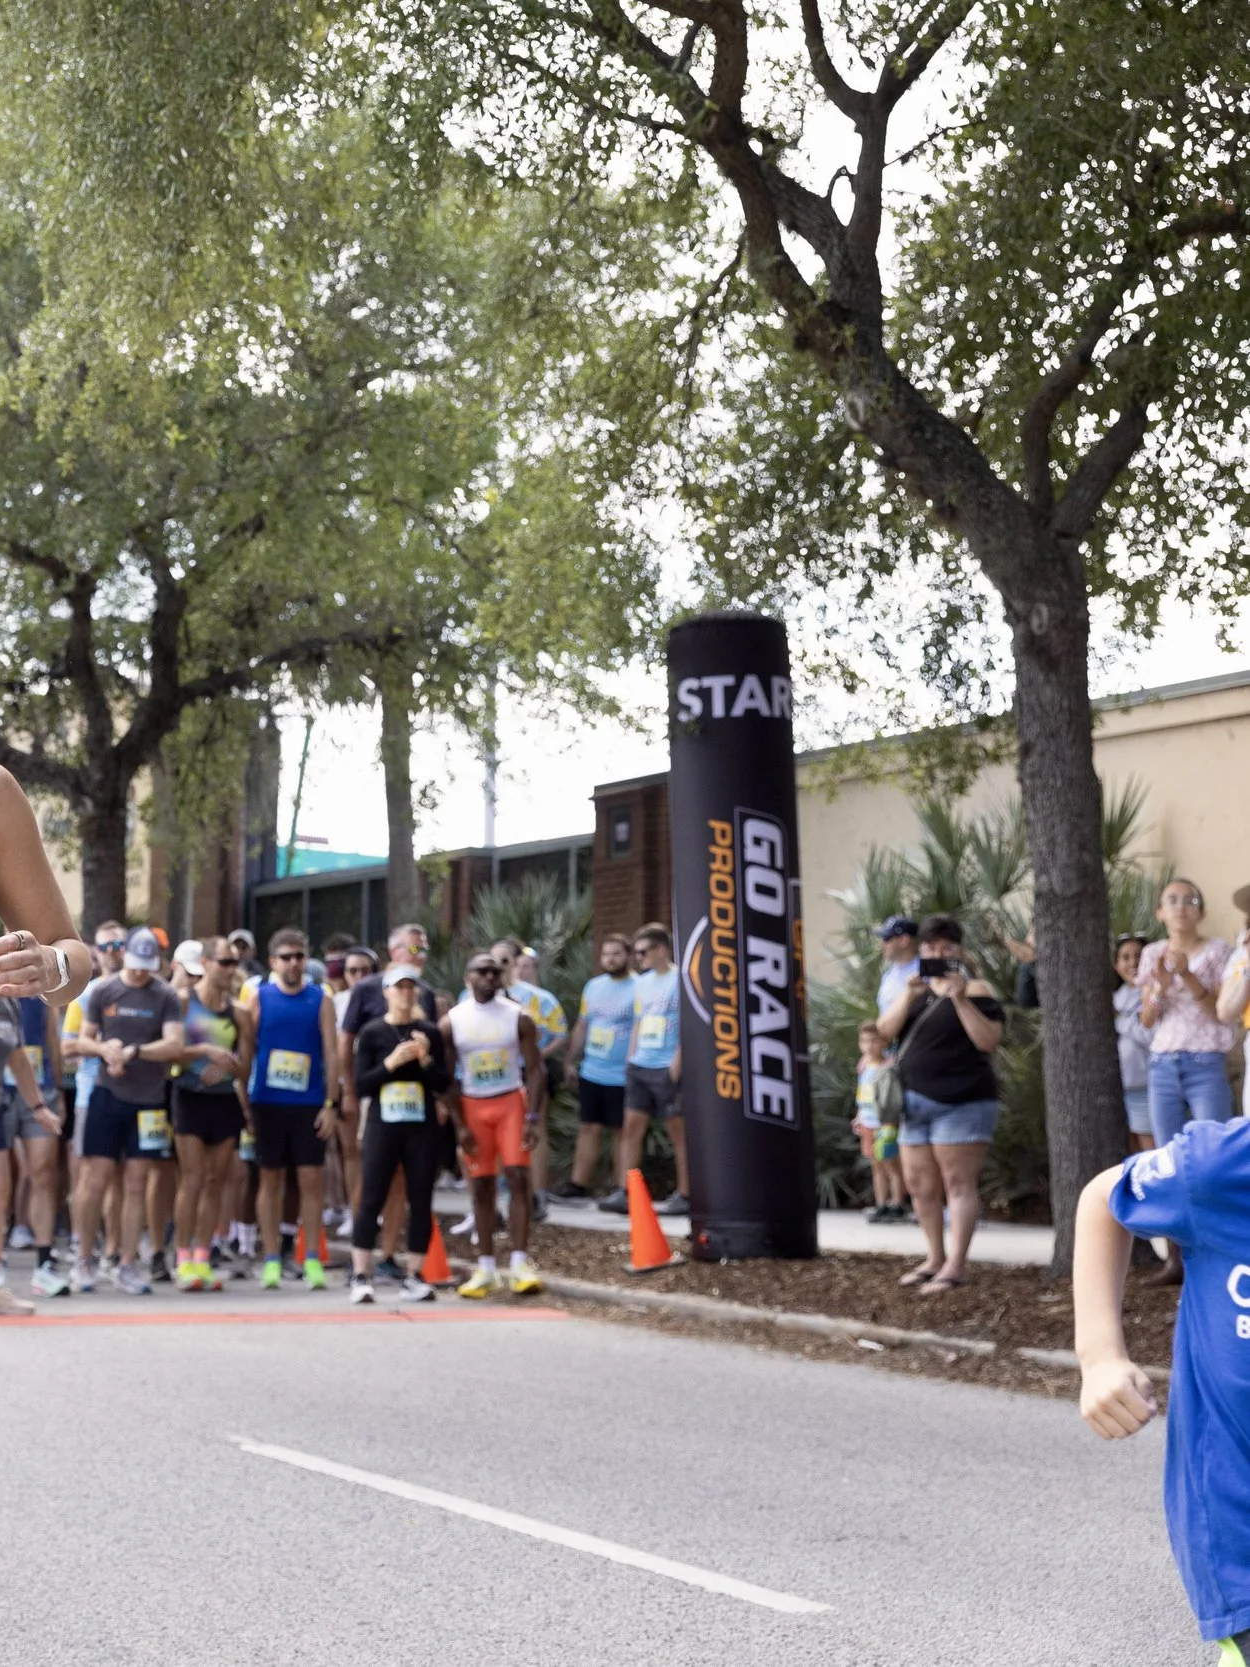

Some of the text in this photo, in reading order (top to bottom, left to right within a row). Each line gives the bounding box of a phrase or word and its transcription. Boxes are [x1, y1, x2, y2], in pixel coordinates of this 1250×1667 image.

[707, 819, 742, 1100] PRODUCTIONS
[742, 818, 795, 1121] GO RACE
